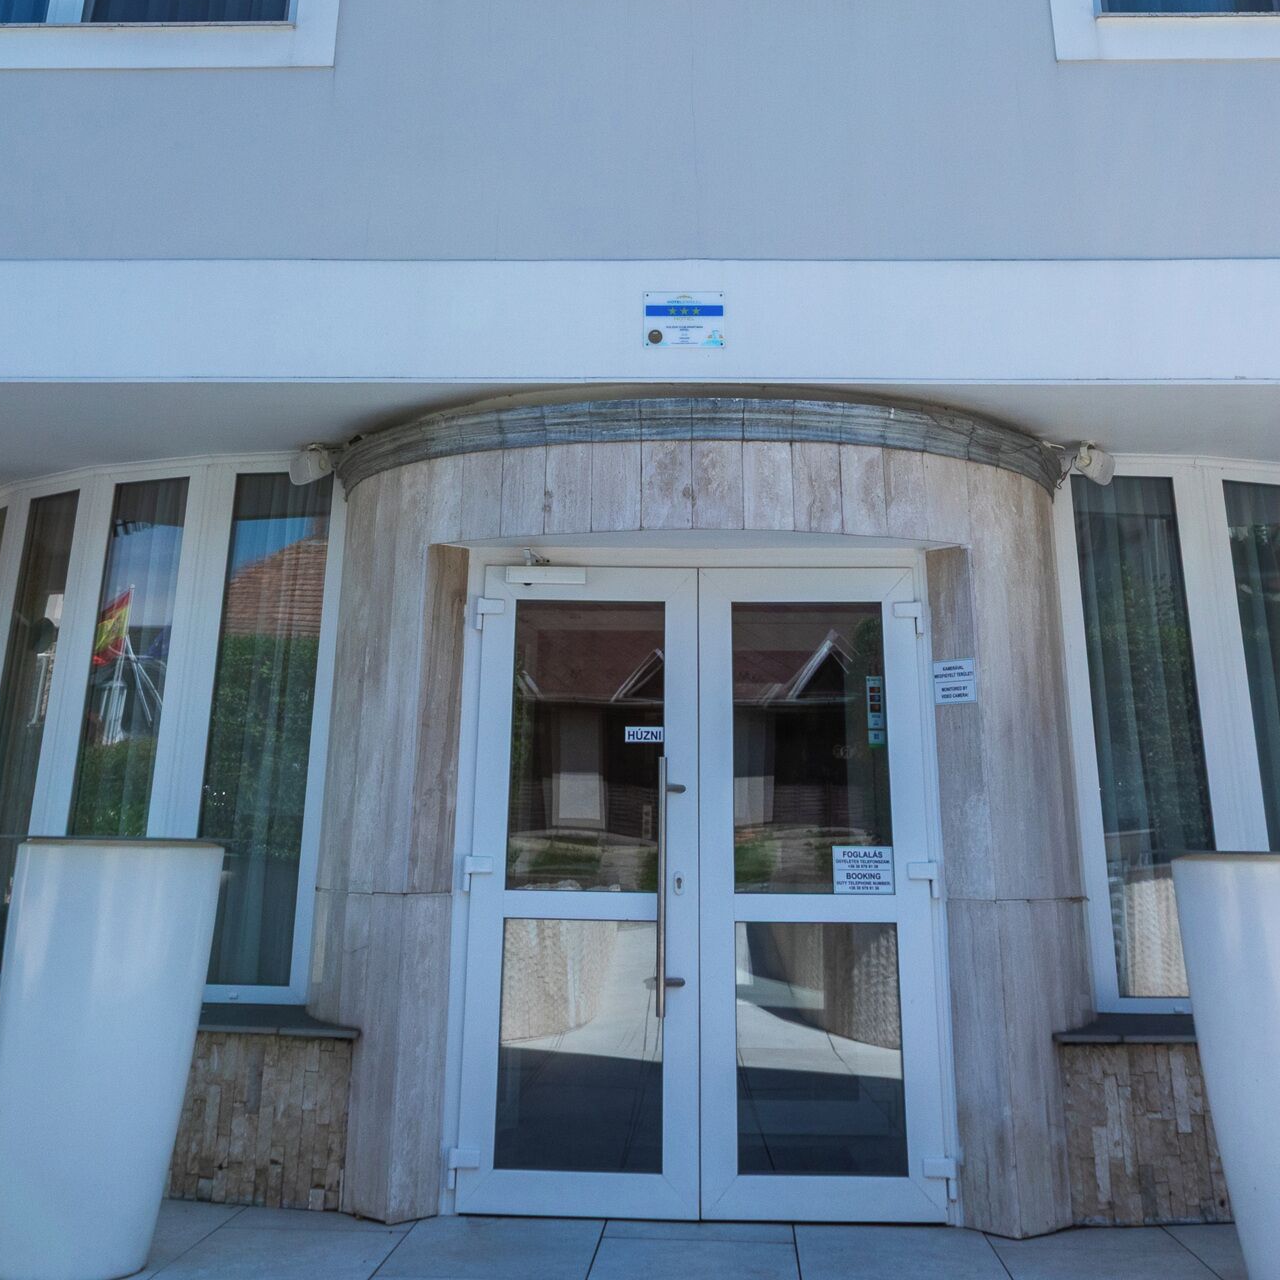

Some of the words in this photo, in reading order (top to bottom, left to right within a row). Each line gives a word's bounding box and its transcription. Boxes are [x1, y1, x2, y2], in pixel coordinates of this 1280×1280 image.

[627, 728, 662, 741] HÚZNI
[842, 850, 883, 859] FOGLALÁS
[846, 872, 881, 880] BOOKING
